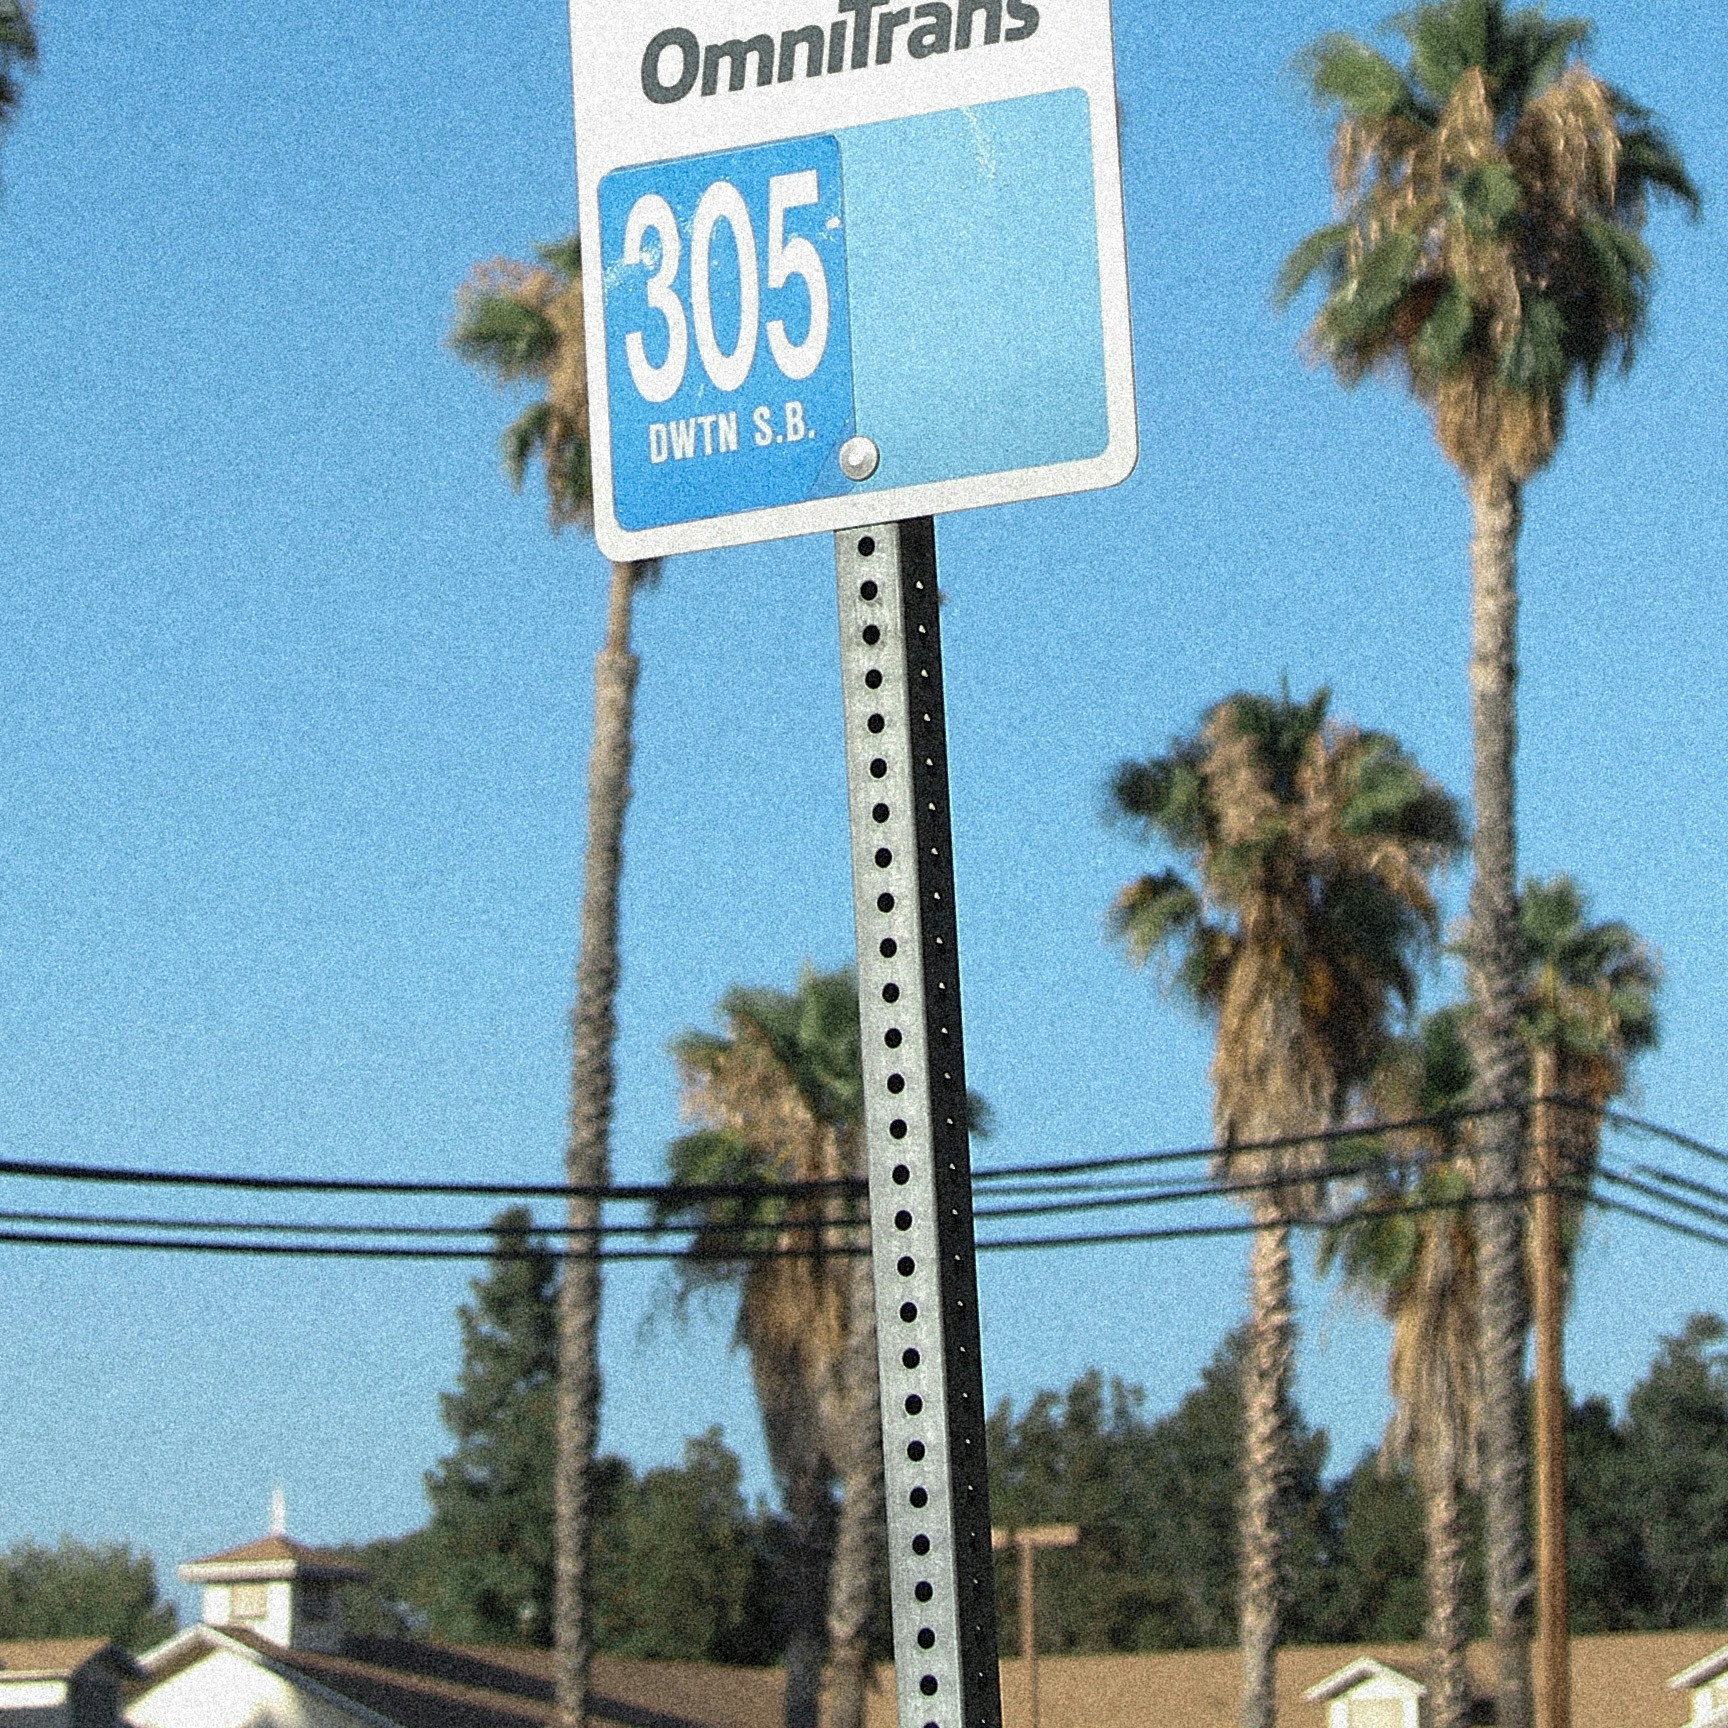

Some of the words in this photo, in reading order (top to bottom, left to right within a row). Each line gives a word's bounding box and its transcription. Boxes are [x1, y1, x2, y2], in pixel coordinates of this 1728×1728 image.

[625, 169, 830, 403] 305
[649, 411, 738, 464] DWTN
[753, 402, 816, 446] S.B.
